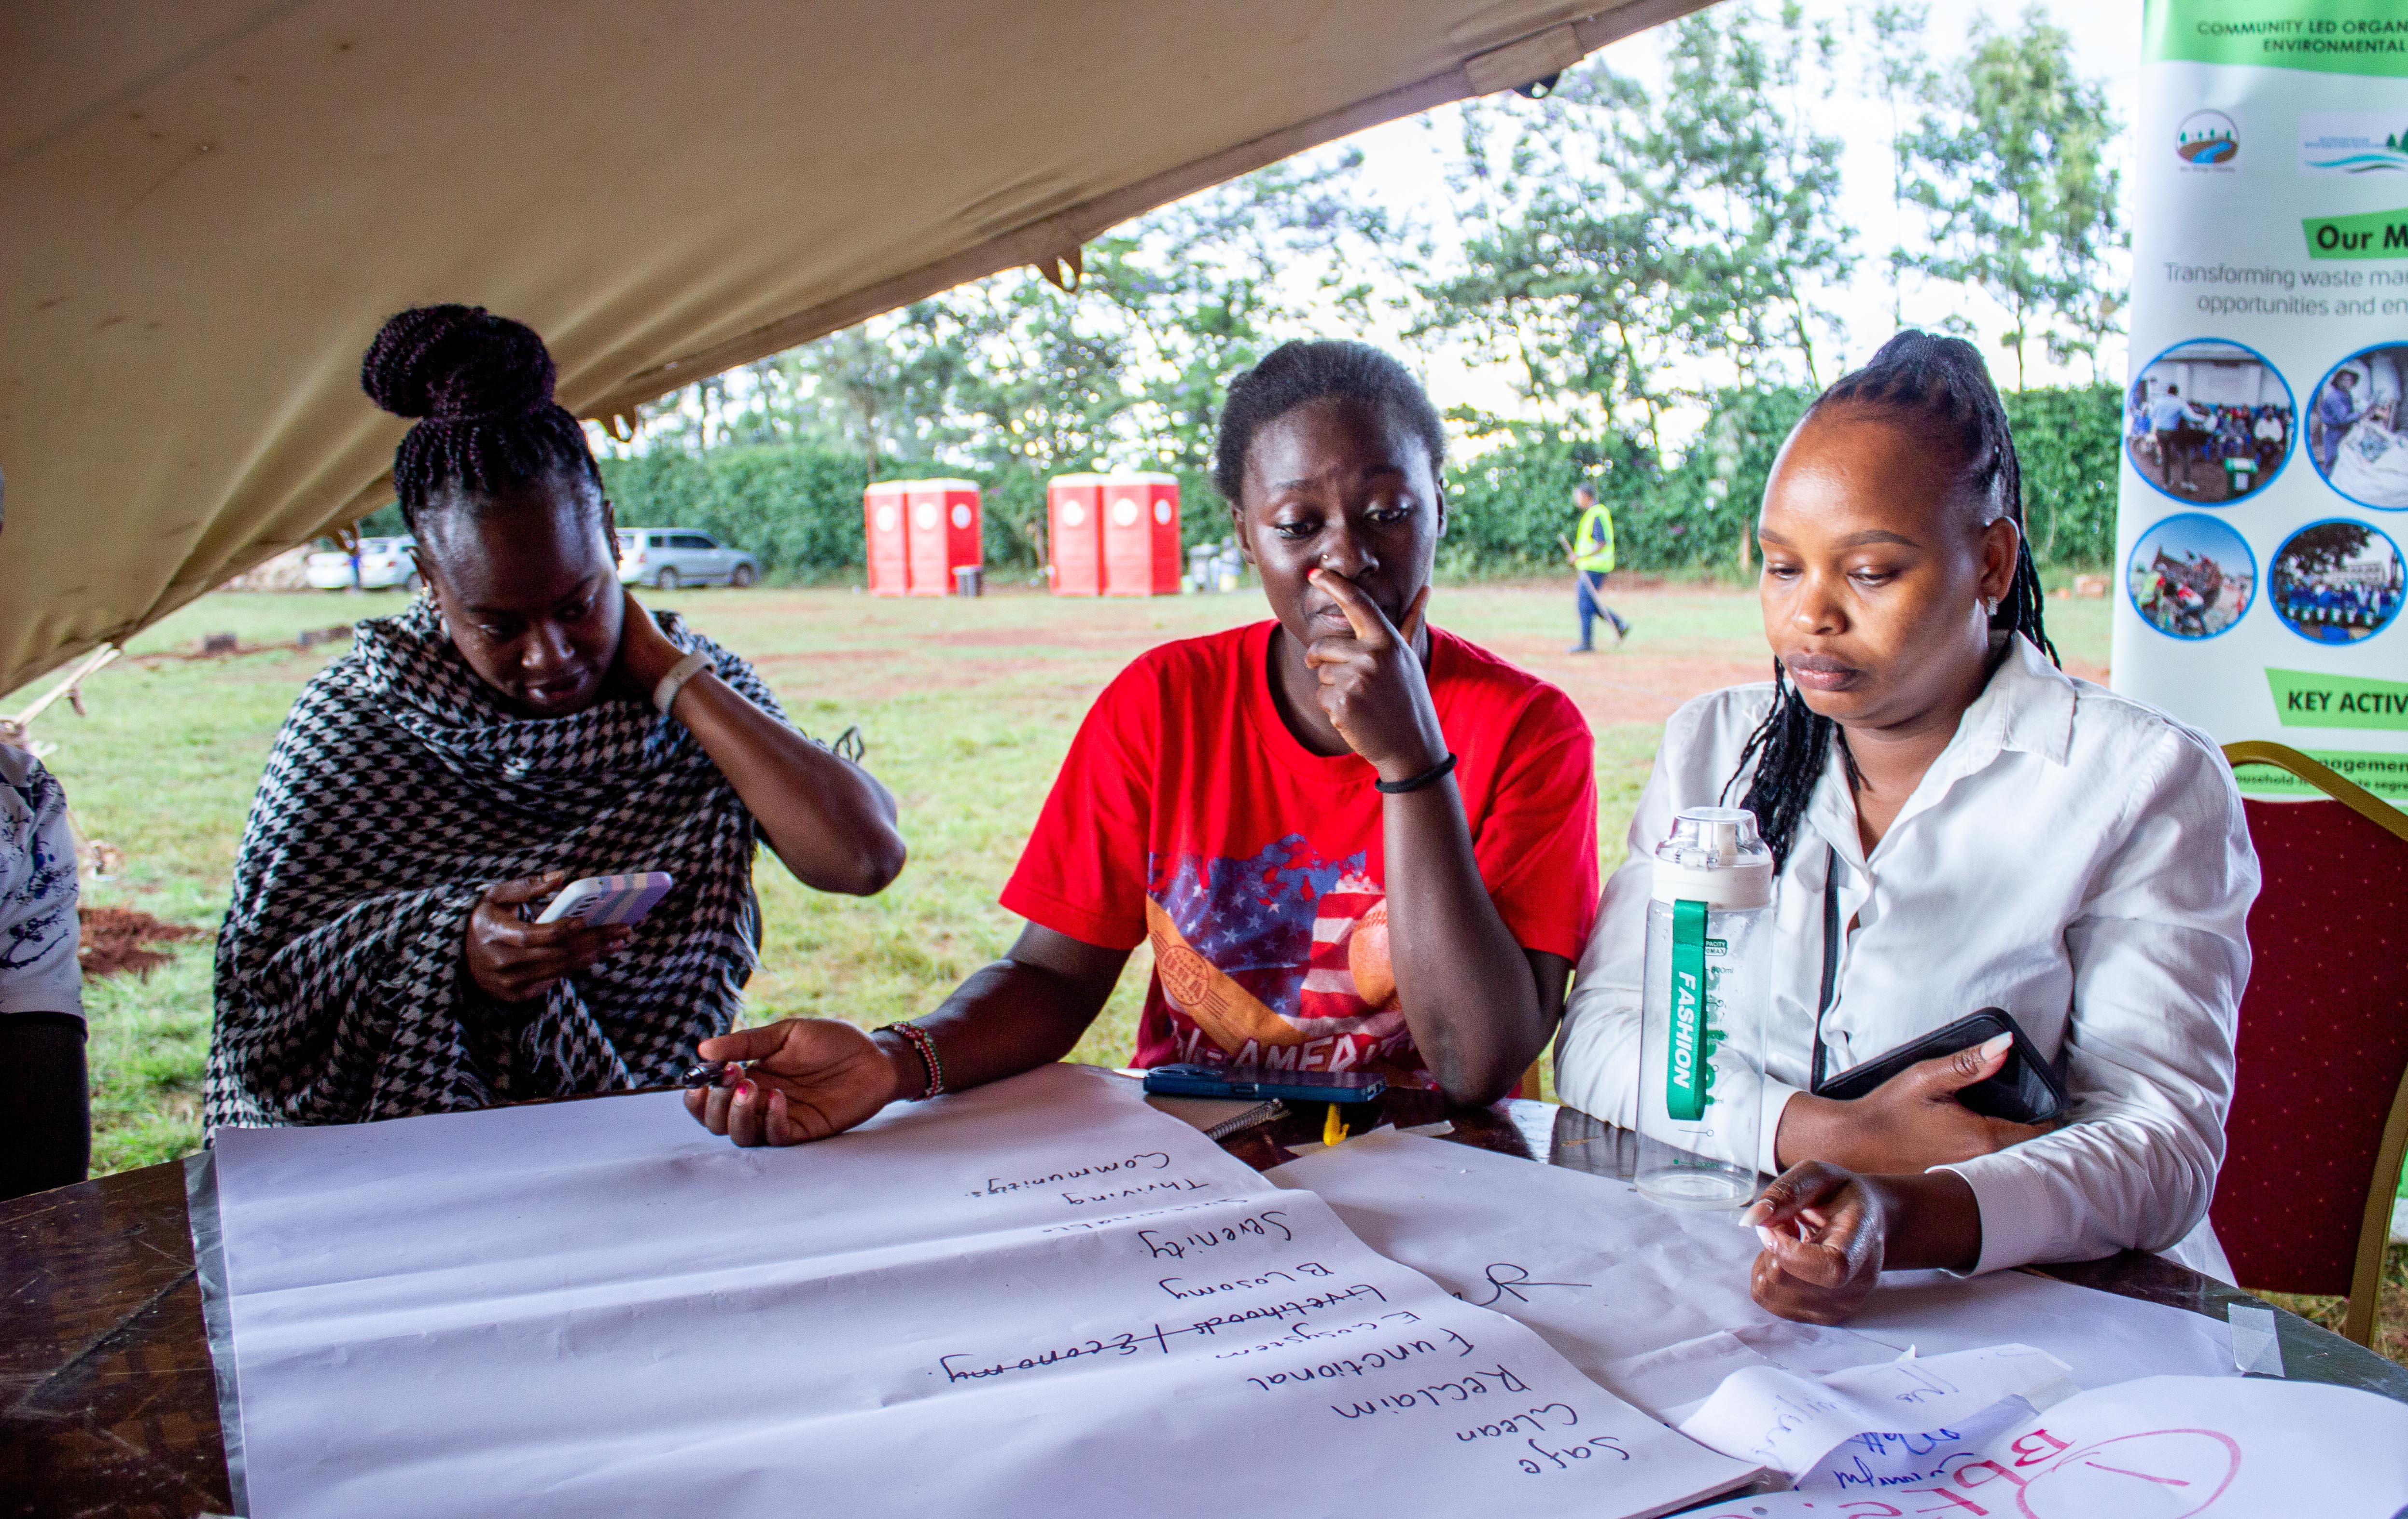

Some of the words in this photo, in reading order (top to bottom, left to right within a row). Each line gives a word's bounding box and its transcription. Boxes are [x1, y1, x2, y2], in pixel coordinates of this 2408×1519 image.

[2197, 20, 2302, 35] COMMUNITY
[2309, 20, 2337, 34] LED
[2263, 38, 2407, 53] ENVIRONMENTAL
[2317, 224, 2373, 250] Our
[2166, 262, 2295, 290] Transforming
[2300, 269, 2363, 287] waste
[2369, 270, 2408, 286] ma
[2197, 295, 2329, 316] opportunities
[2334, 297, 2375, 316] and
[2288, 690, 2332, 712] KEY
[1673, 971, 1697, 1089] FASHION
[1247, 1327, 1475, 1392] Functional
[1518, 1436, 1631, 1475] Safe
